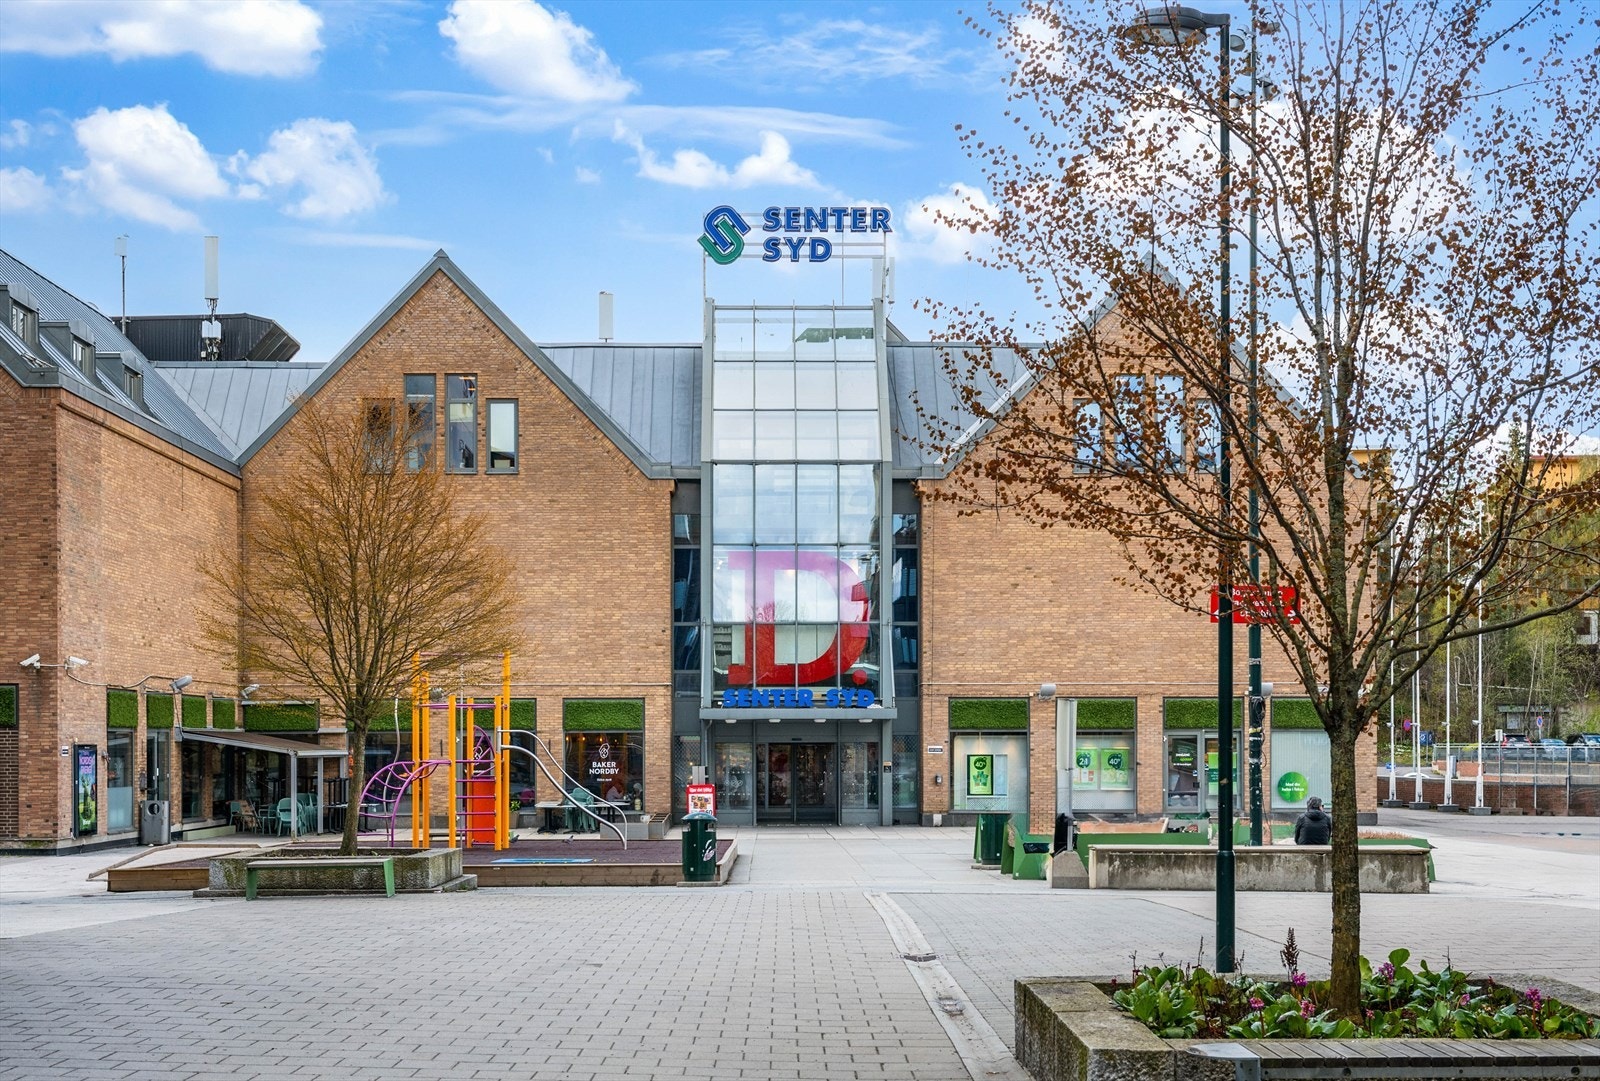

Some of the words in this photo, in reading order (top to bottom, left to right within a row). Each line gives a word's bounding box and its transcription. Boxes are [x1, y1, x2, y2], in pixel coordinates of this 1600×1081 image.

[762, 206, 893, 233] SENTER
[762, 236, 833, 263] SYD
[723, 688, 814, 708] SENTER
[825, 687, 876, 708] SYD
